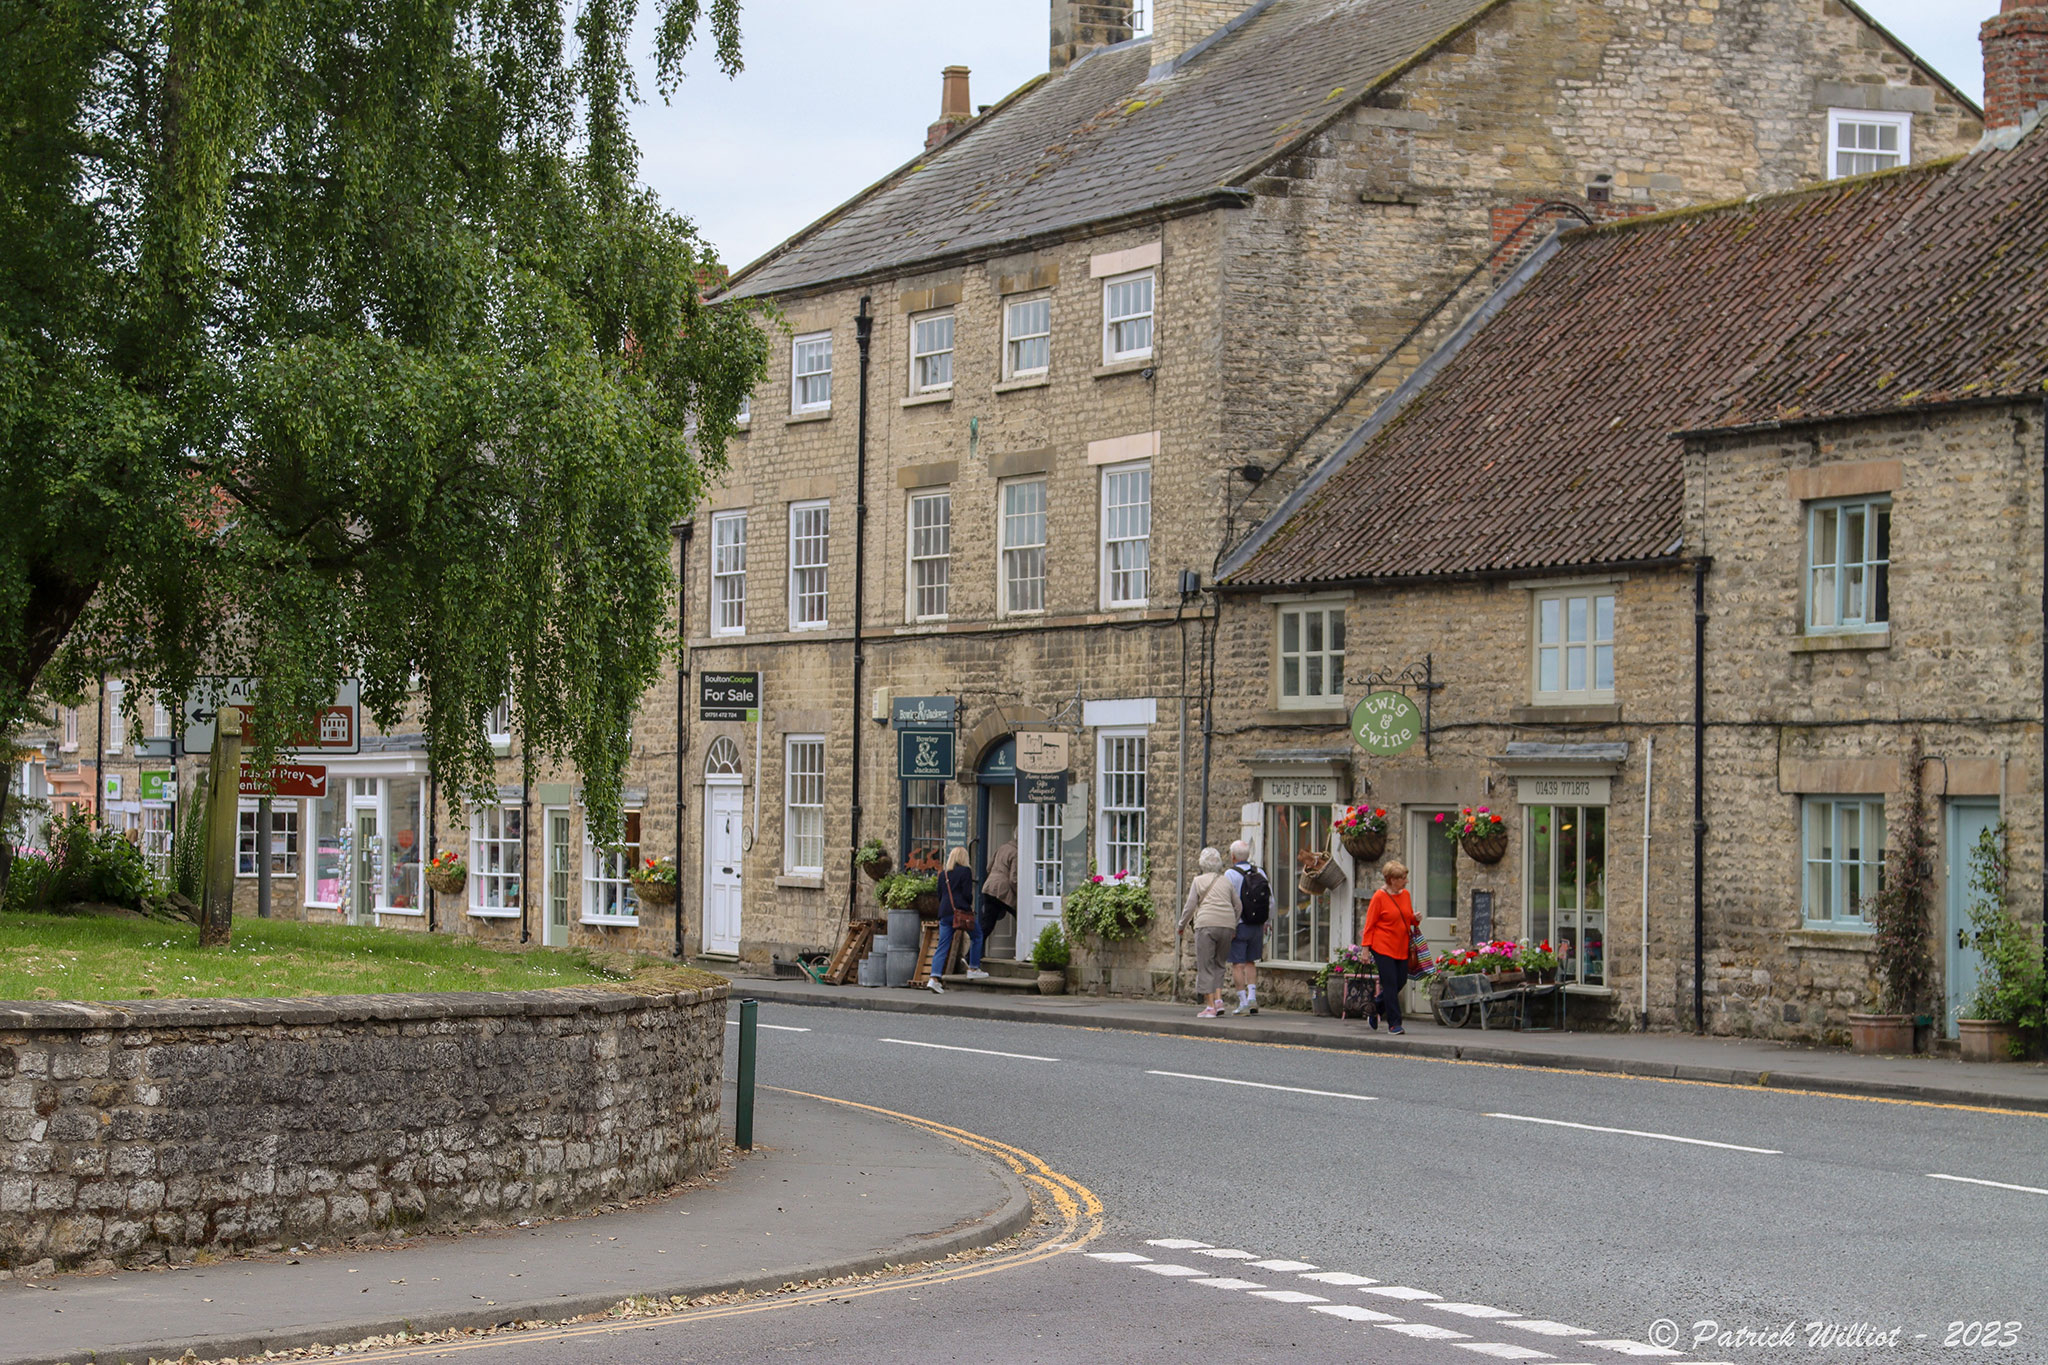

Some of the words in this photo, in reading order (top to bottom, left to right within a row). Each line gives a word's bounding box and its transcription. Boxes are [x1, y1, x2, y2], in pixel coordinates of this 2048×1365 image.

[704, 675, 754, 684] BoultonCooper
[704, 689, 726, 701] For
[727, 689, 754, 701] Sale
[1365, 695, 1409, 717] twig
[1380, 714, 1393, 729] &
[916, 736, 939, 744] Bowley
[1359, 722, 1412, 748] twine
[915, 742, 939, 767] &
[239, 769, 261, 778] irds
[281, 769, 305, 781] Prey
[239, 782, 268, 791] entre
[1271, 781, 1291, 797] twig
[1293, 781, 1300, 796] &
[1302, 781, 1327, 795] twine
[1535, 781, 1558, 795] 01439
[1561, 781, 1590, 795] 771873
